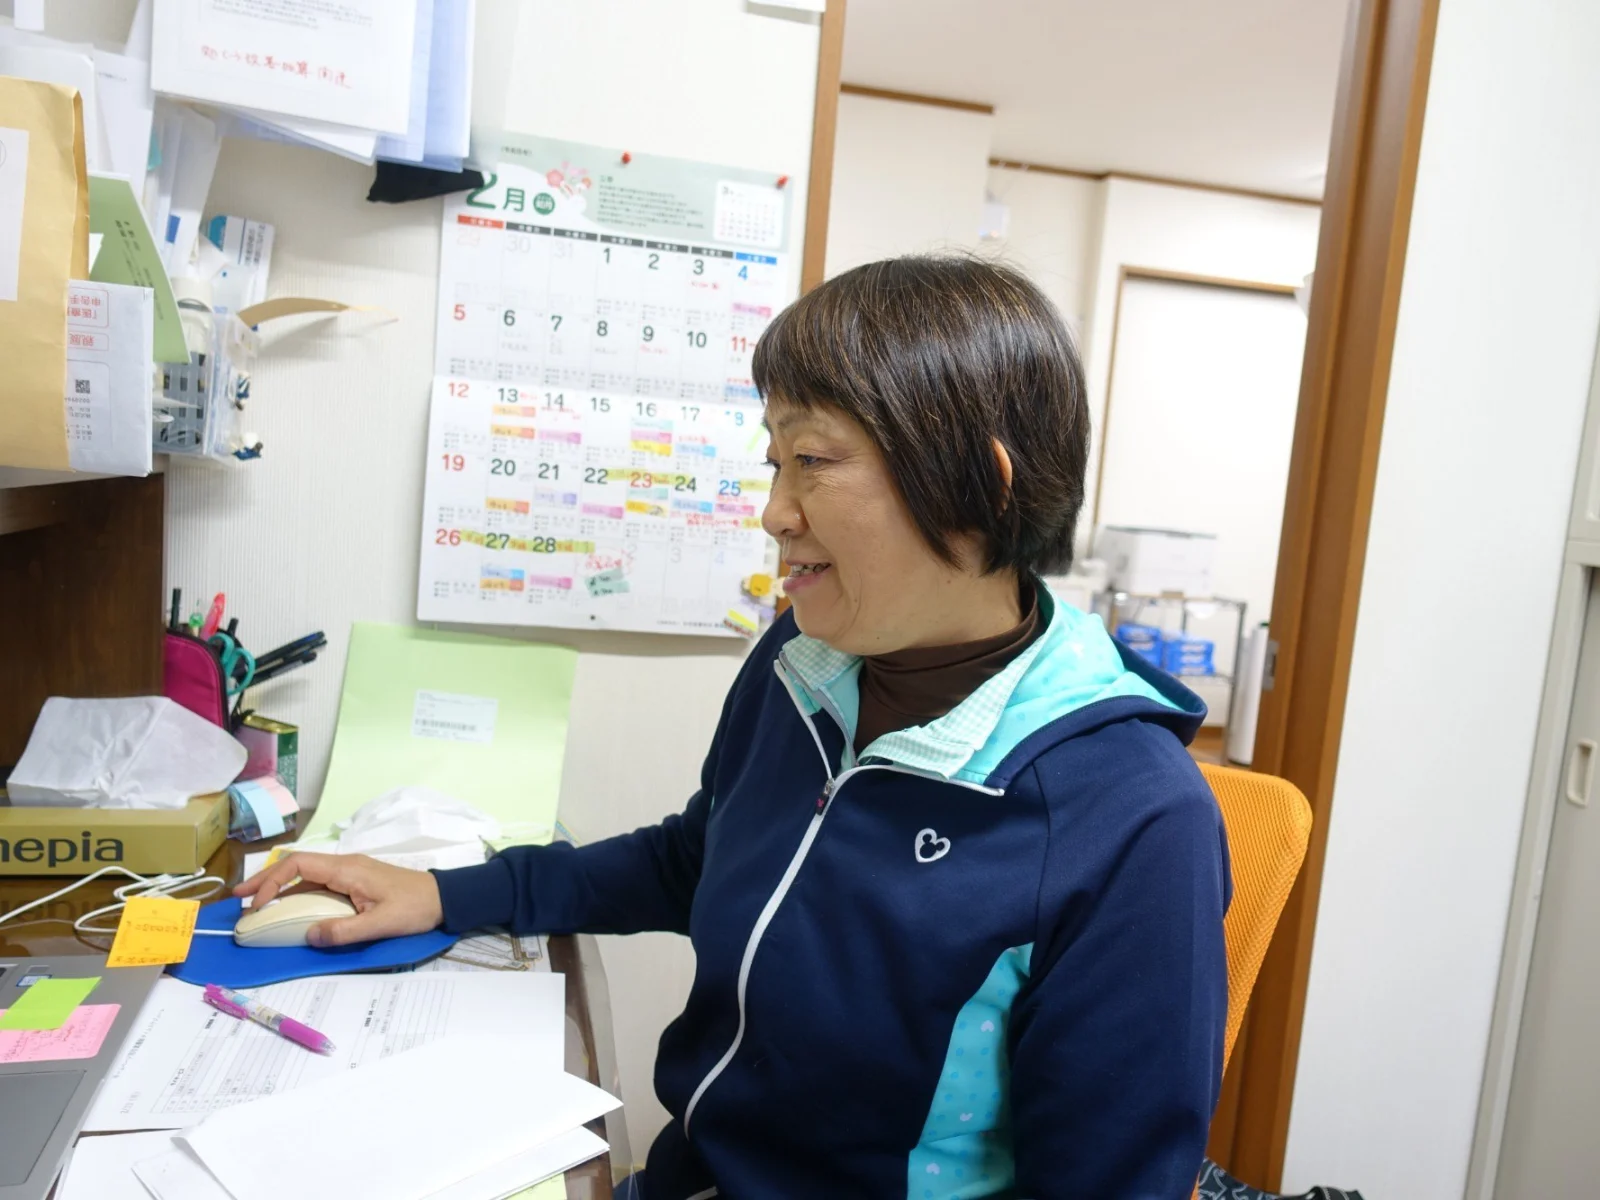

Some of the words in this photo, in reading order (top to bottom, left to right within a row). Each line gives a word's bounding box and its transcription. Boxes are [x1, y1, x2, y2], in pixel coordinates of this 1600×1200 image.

[466, 172, 526, 212] 2月
[603, 248, 611, 264] 1
[648, 253, 660, 270] 2
[693, 259, 705, 275] 3
[738, 265, 749, 281] 4
[453, 304, 466, 321] 5
[503, 310, 516, 327] 6
[550, 314, 563, 332] 7
[596, 321, 609, 337] 8
[642, 325, 654, 342] 9
[687, 331, 707, 348] 10
[732, 336, 746, 353] 11
[448, 382, 469, 398] 12
[498, 387, 518, 403] 13
[545, 392, 565, 410] 14
[590, 396, 611, 412] 15
[636, 401, 657, 417] 16
[681, 406, 700, 421] 17
[442, 453, 465, 471] 19
[491, 458, 516, 476] 20
[538, 463, 559, 479] 21
[584, 467, 609, 485] 22
[629, 471, 652, 488] 23
[675, 475, 697, 492] 24
[718, 479, 741, 497] 25
[435, 528, 462, 546] 26
[486, 532, 510, 550] 27
[532, 536, 557, 553] 28
